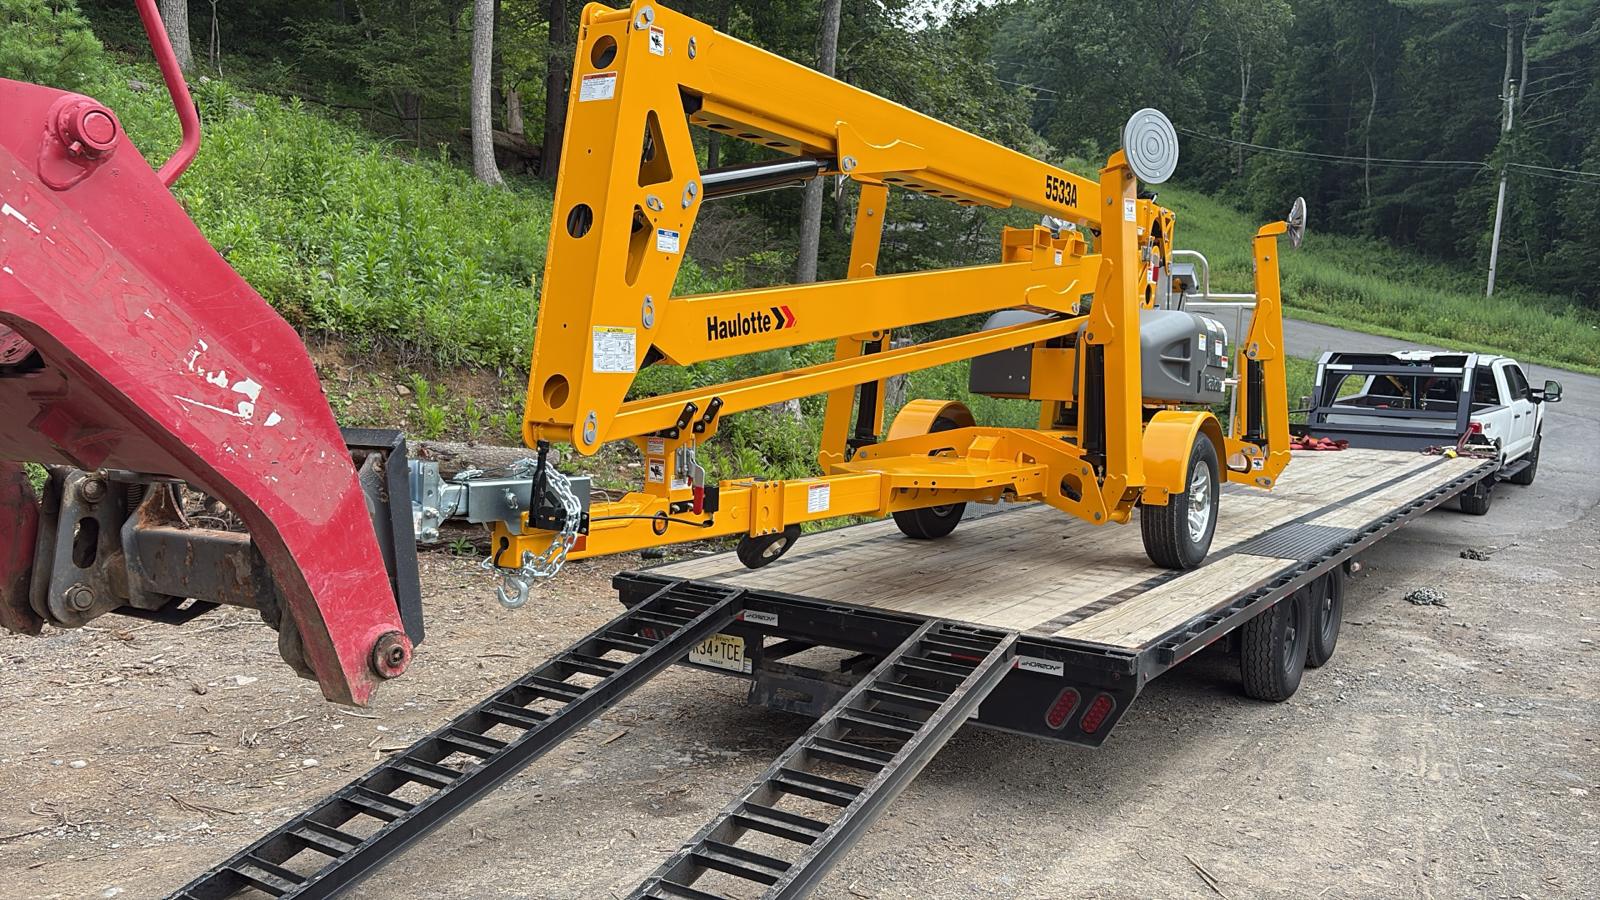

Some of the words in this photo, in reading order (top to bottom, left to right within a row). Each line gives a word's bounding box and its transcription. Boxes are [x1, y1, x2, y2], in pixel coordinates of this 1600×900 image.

[1045, 174, 1078, 208] 5533A
[707, 311, 771, 341] Haulotte
[720, 642, 740, 661] TCE
